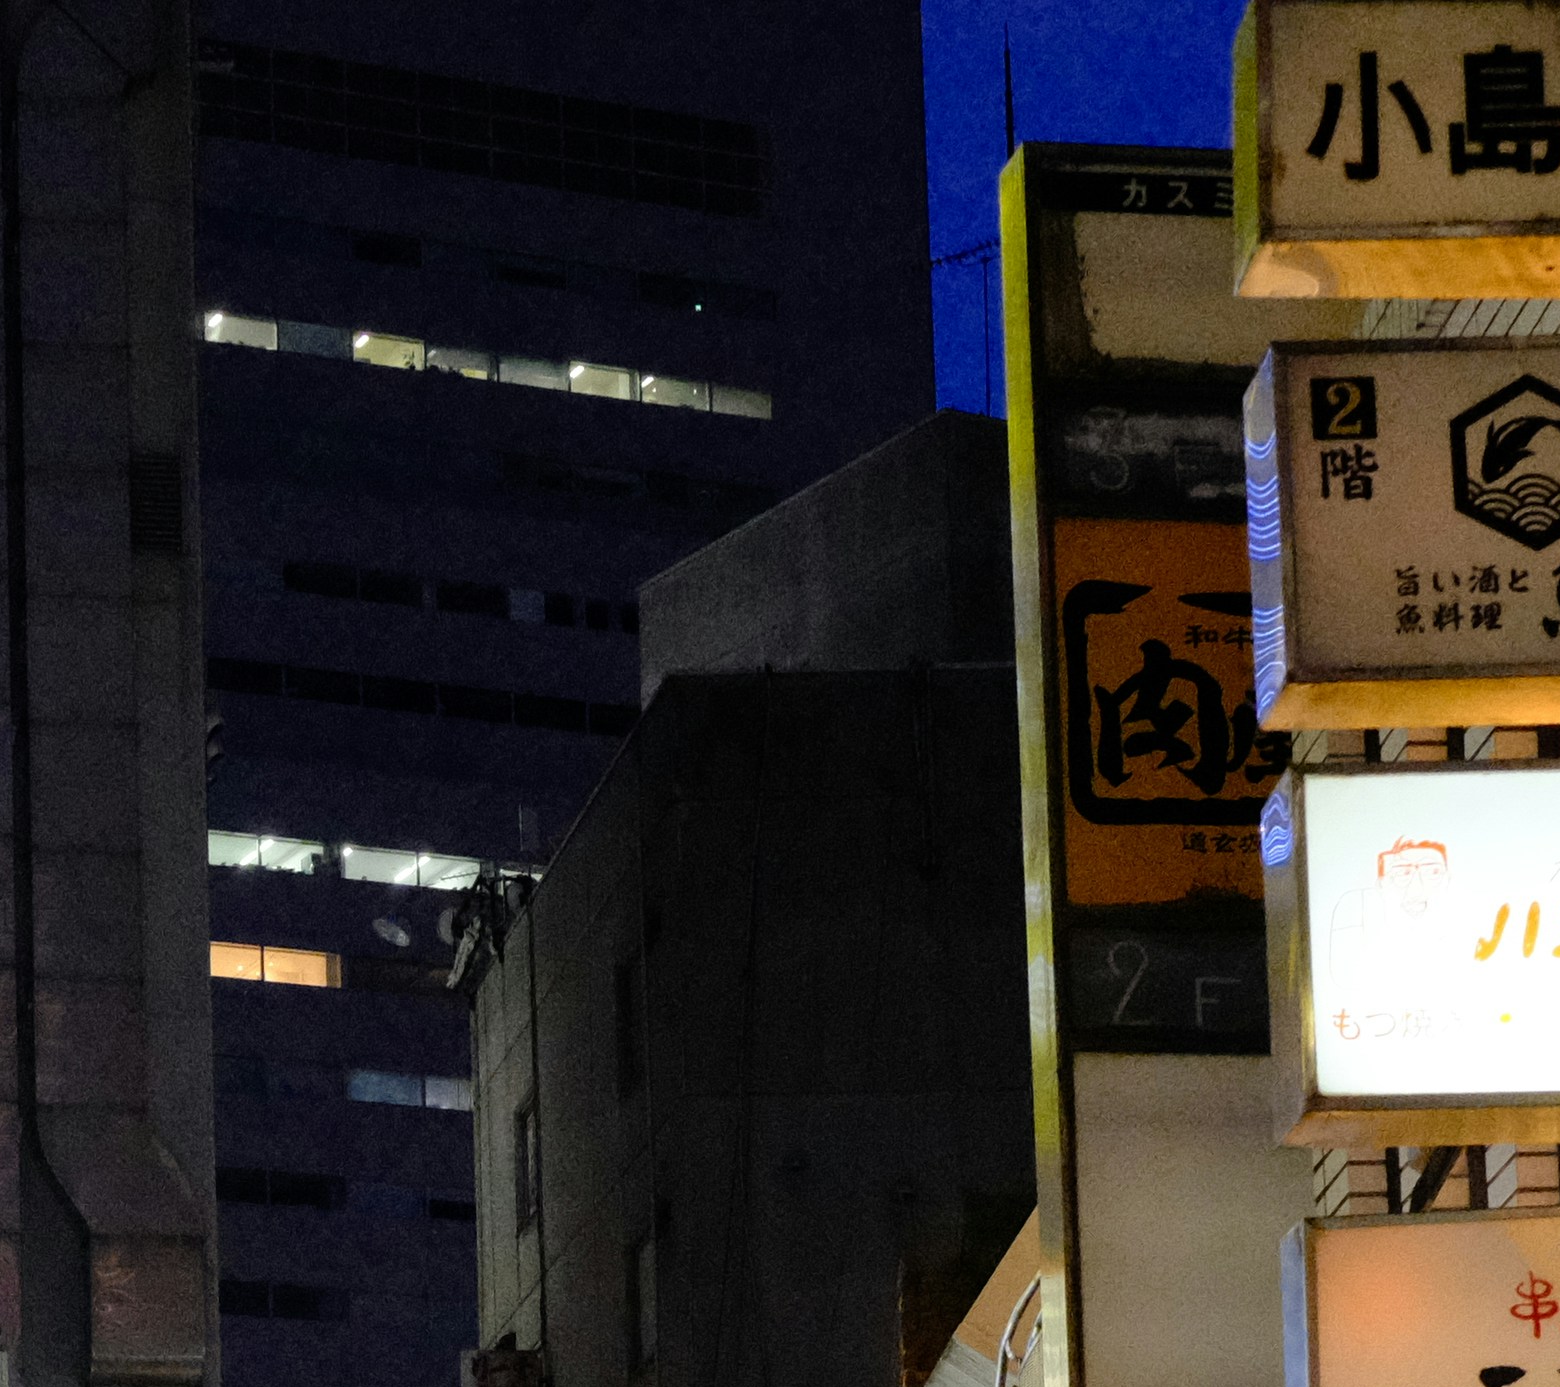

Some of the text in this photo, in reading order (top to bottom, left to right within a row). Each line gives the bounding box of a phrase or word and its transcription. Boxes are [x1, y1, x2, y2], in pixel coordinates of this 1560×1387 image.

[1321, 381, 1378, 501] 2階
[1395, 567, 1530, 595] 旨い酒と
[1394, 601, 1502, 635] 魚料理
[1185, 625, 1252, 650] 和牛
[1108, 940, 1243, 1031] 2F
